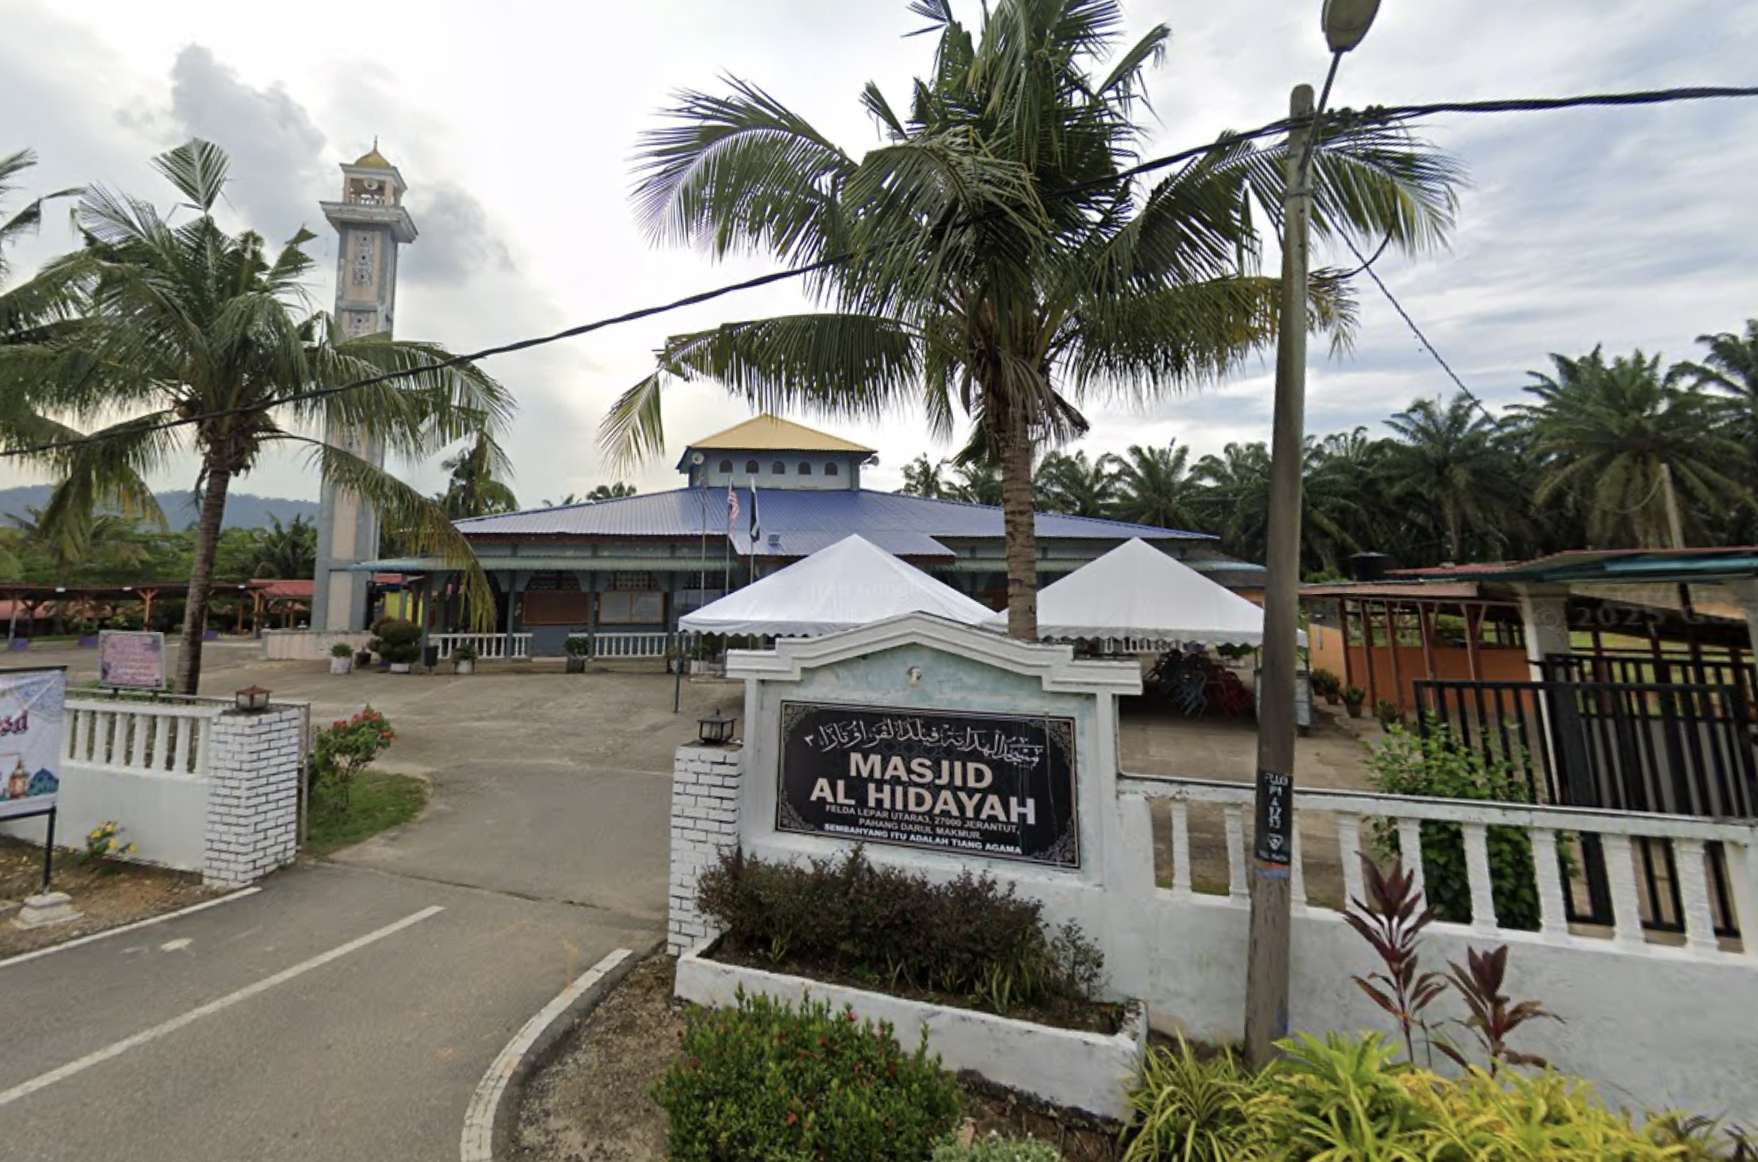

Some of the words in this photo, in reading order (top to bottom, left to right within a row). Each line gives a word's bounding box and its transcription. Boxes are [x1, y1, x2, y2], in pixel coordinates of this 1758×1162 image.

[849, 752, 993, 789] MASJID
[809, 777, 856, 806] AL
[867, 783, 1036, 825] HIDAYAH
[825, 804, 856, 815] FELDA
[857, 808, 889, 819] LEPAR
[934, 817, 962, 827] 27000
[964, 820, 1020, 835] JERANTUT,
[858, 818, 899, 830] PAHANG
[900, 823, 934, 834] DARUL
[823, 823, 889, 838] SEMBAHYANG
[890, 831, 908, 840] ITU
[909, 833, 949, 845] ADALAH
[951, 838, 983, 850] TIANG
[984, 843, 1022, 855] AGAMA
